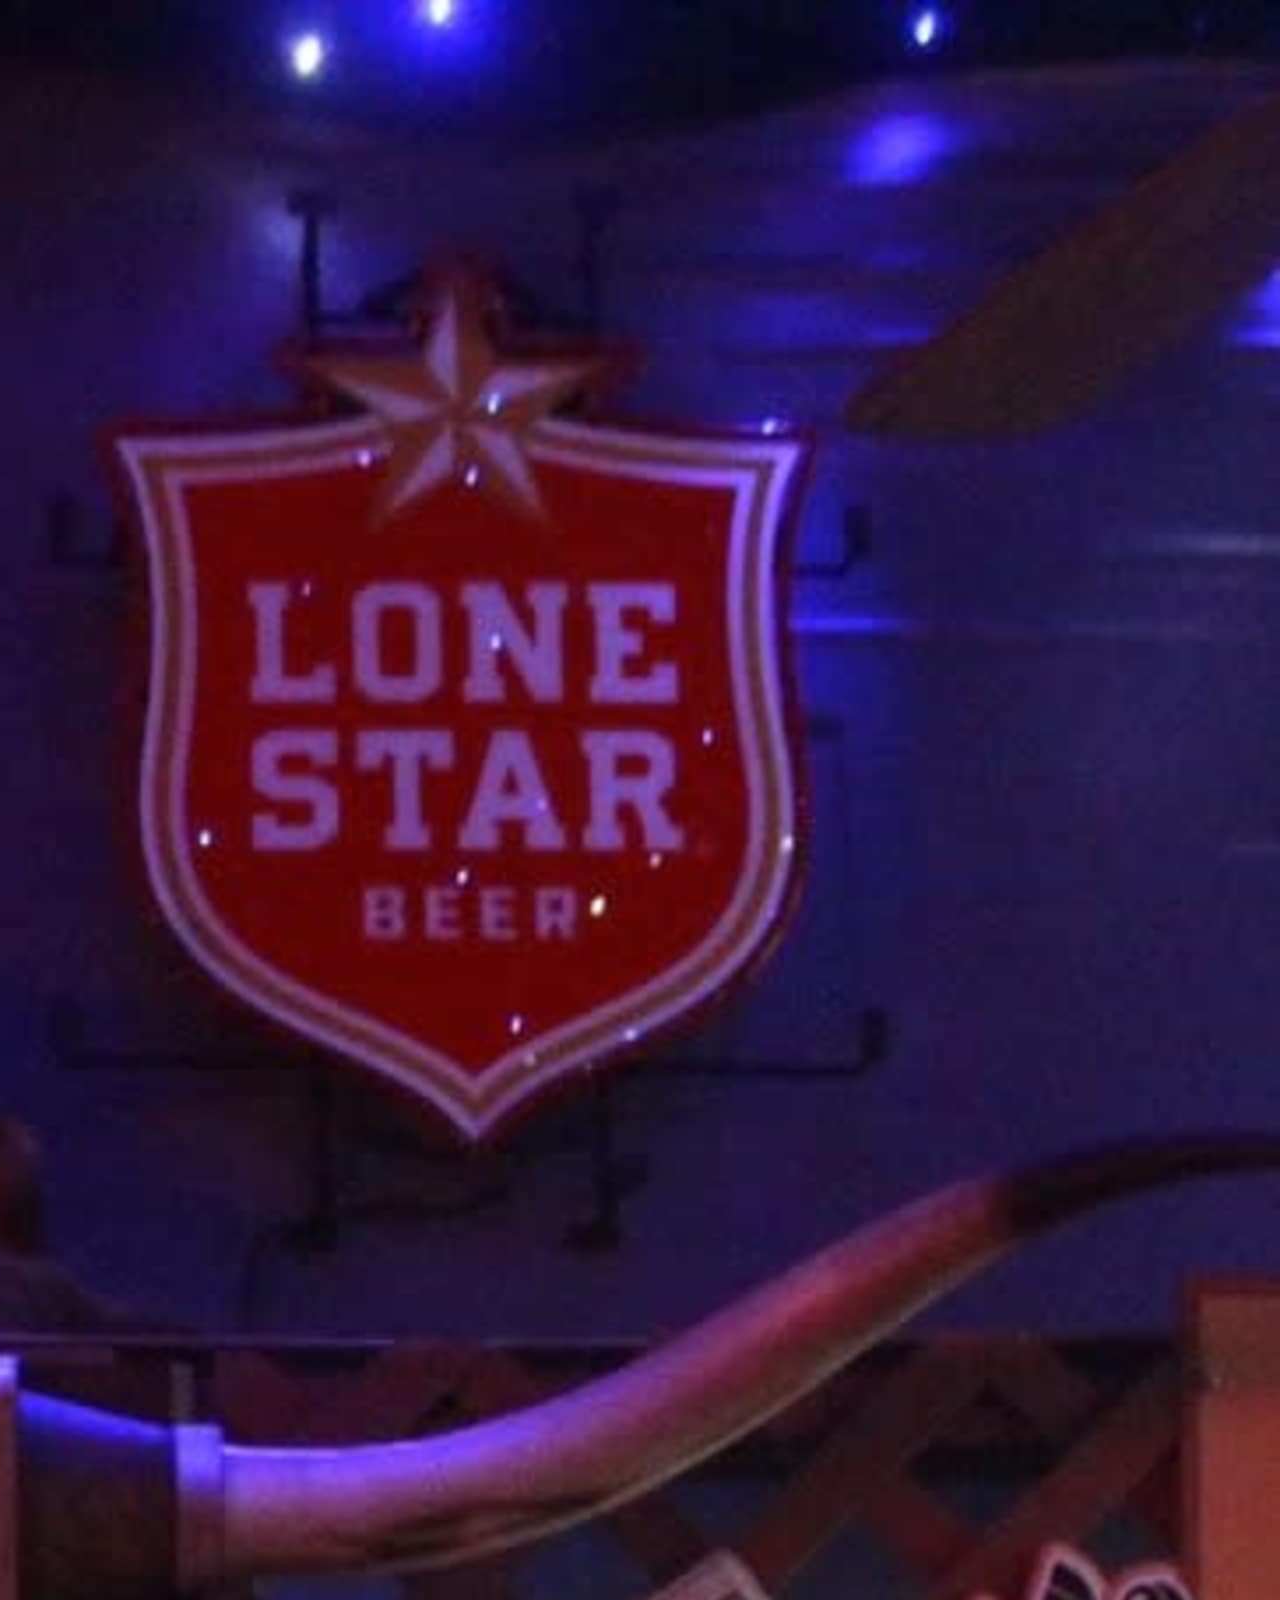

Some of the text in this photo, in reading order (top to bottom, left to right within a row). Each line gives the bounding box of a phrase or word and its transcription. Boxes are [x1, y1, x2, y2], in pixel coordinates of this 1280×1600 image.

[246, 579, 681, 704] LONE
[249, 729, 685, 852] STAR
[363, 885, 578, 942] BEER
